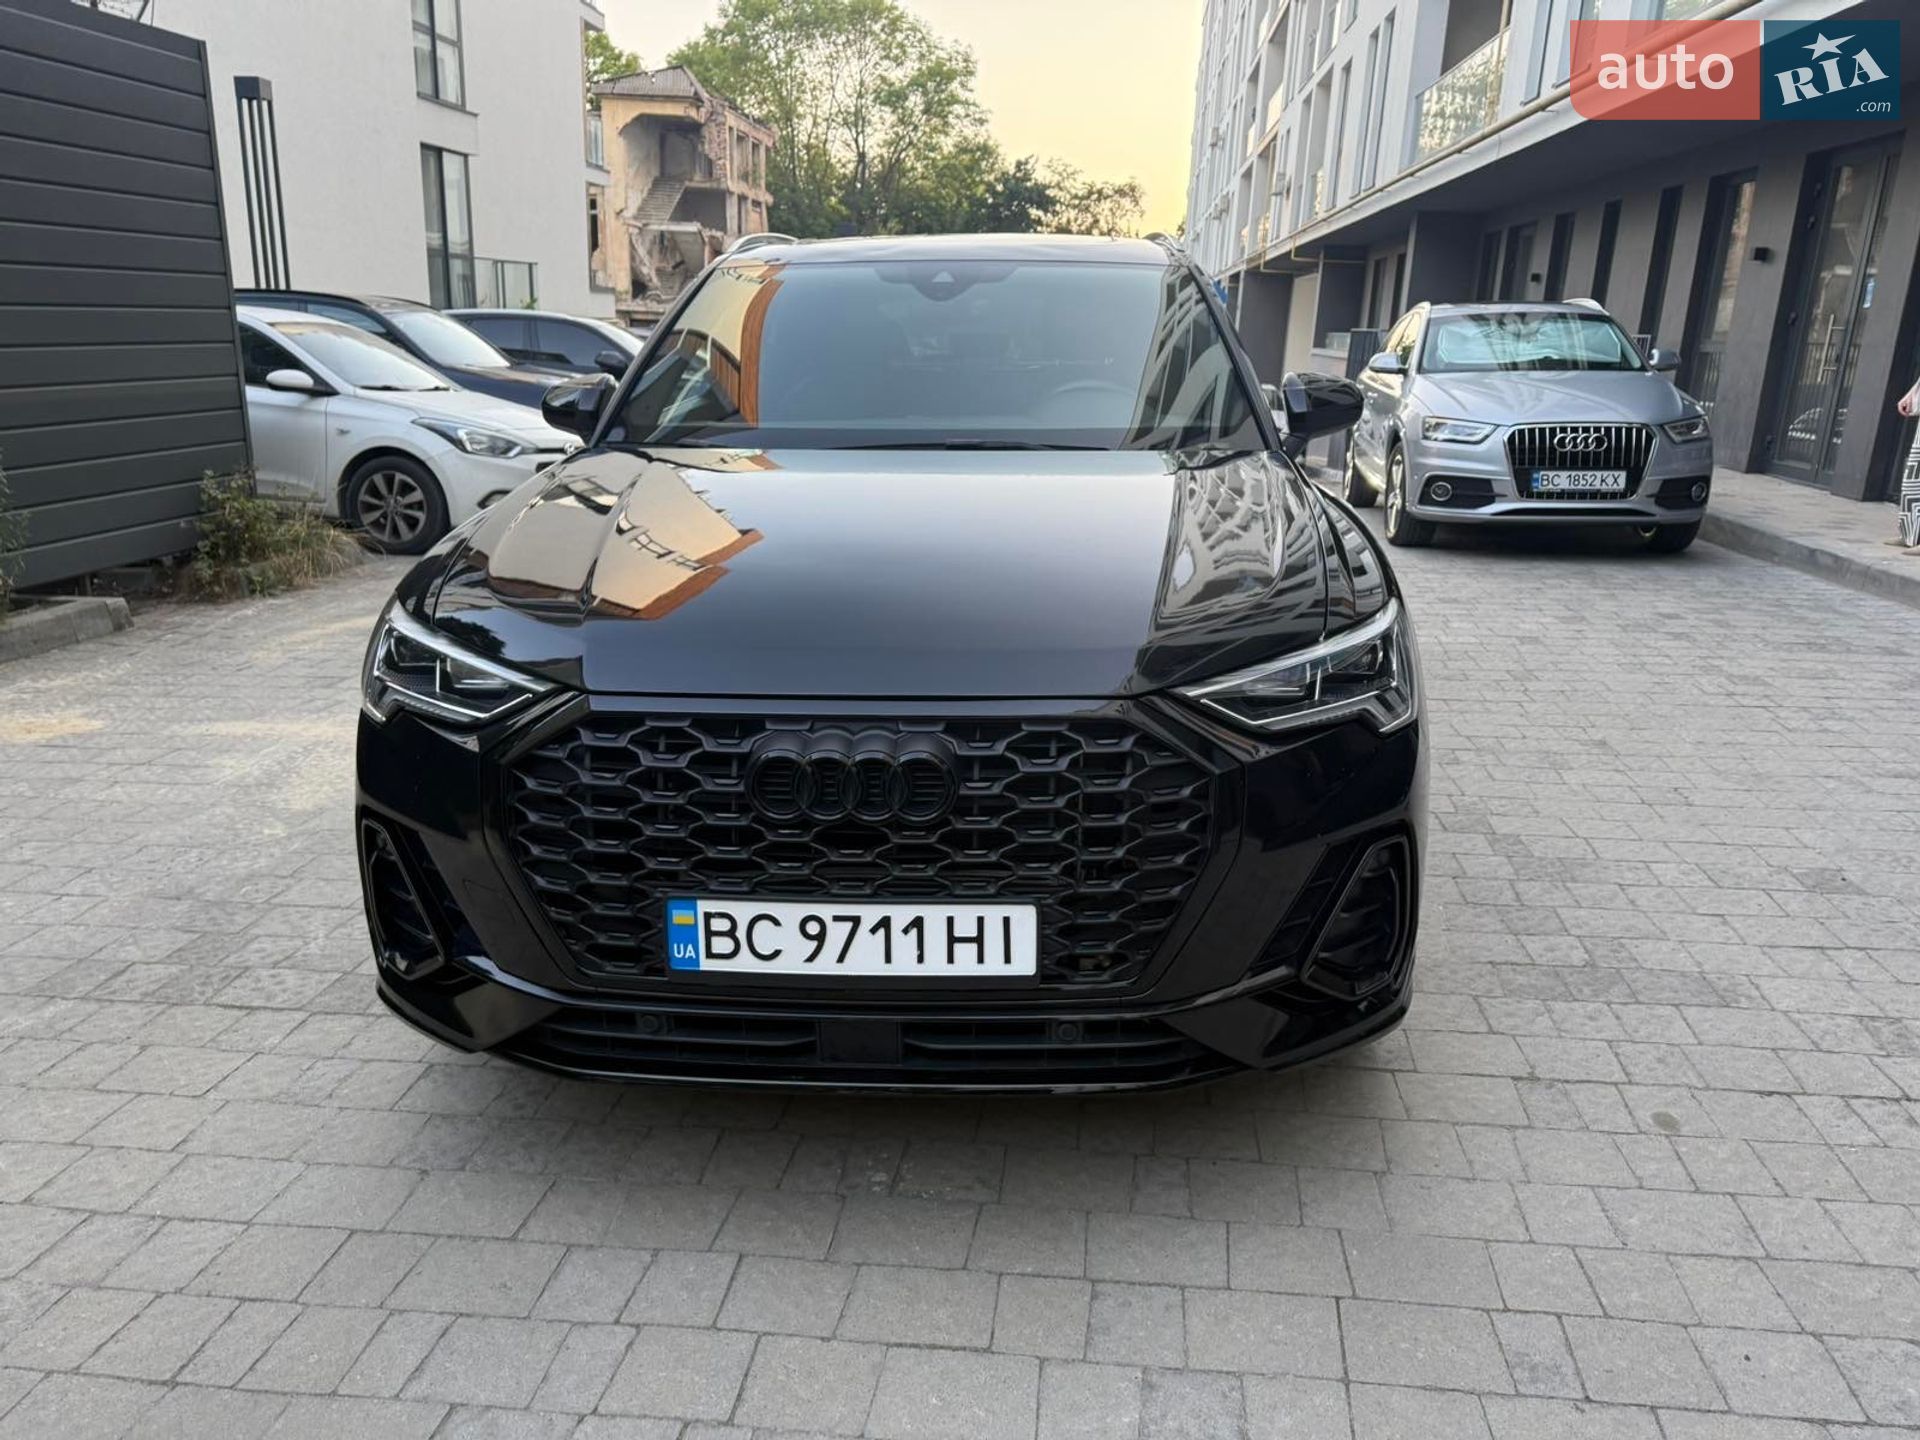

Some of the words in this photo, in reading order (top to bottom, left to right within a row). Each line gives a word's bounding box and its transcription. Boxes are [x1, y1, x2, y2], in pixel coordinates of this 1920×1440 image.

[1540, 473, 1561, 488] BC
[1566, 473, 1597, 488] 1852
[1600, 473, 1621, 488] KX
[703, 910, 784, 962] BC
[798, 914, 925, 965] 9711
[946, 915, 1012, 965] HI
[673, 943, 696, 959] UA
